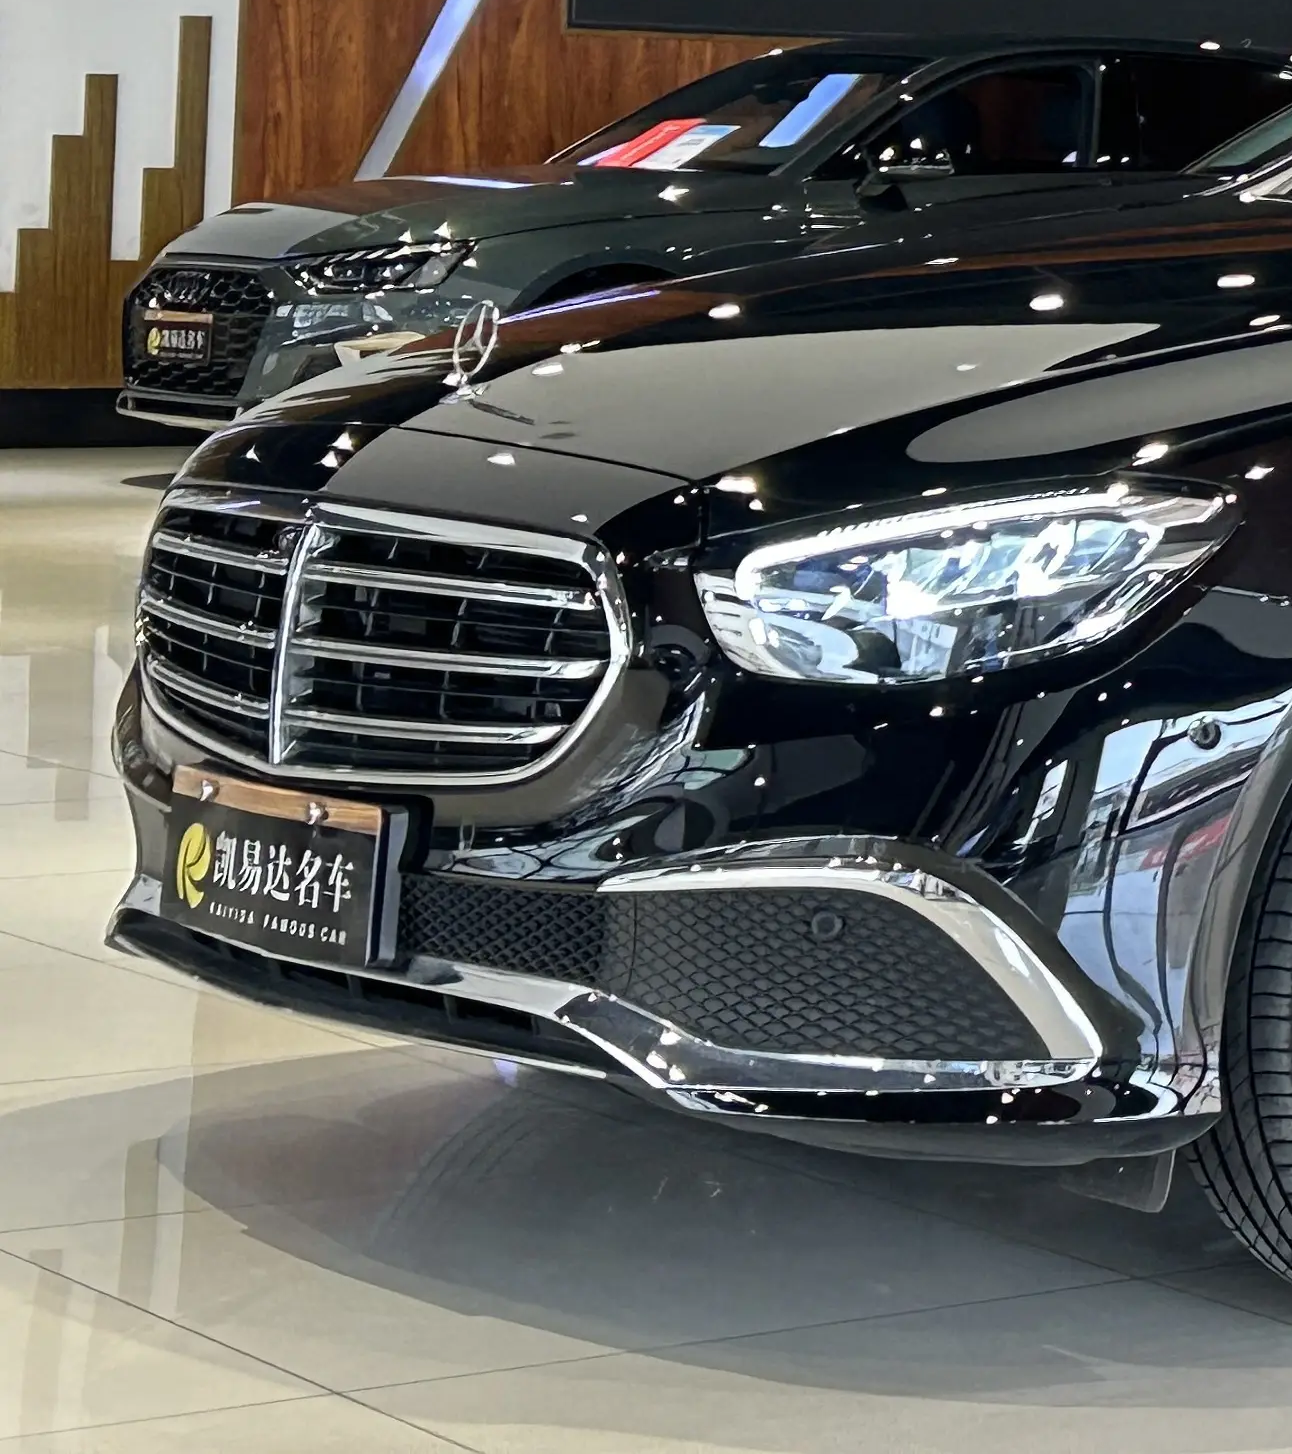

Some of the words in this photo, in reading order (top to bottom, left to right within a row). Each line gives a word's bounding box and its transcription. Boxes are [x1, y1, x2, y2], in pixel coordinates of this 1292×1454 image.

[212, 830, 354, 913] 凯易达名车
[320, 926, 347, 946] CAR
